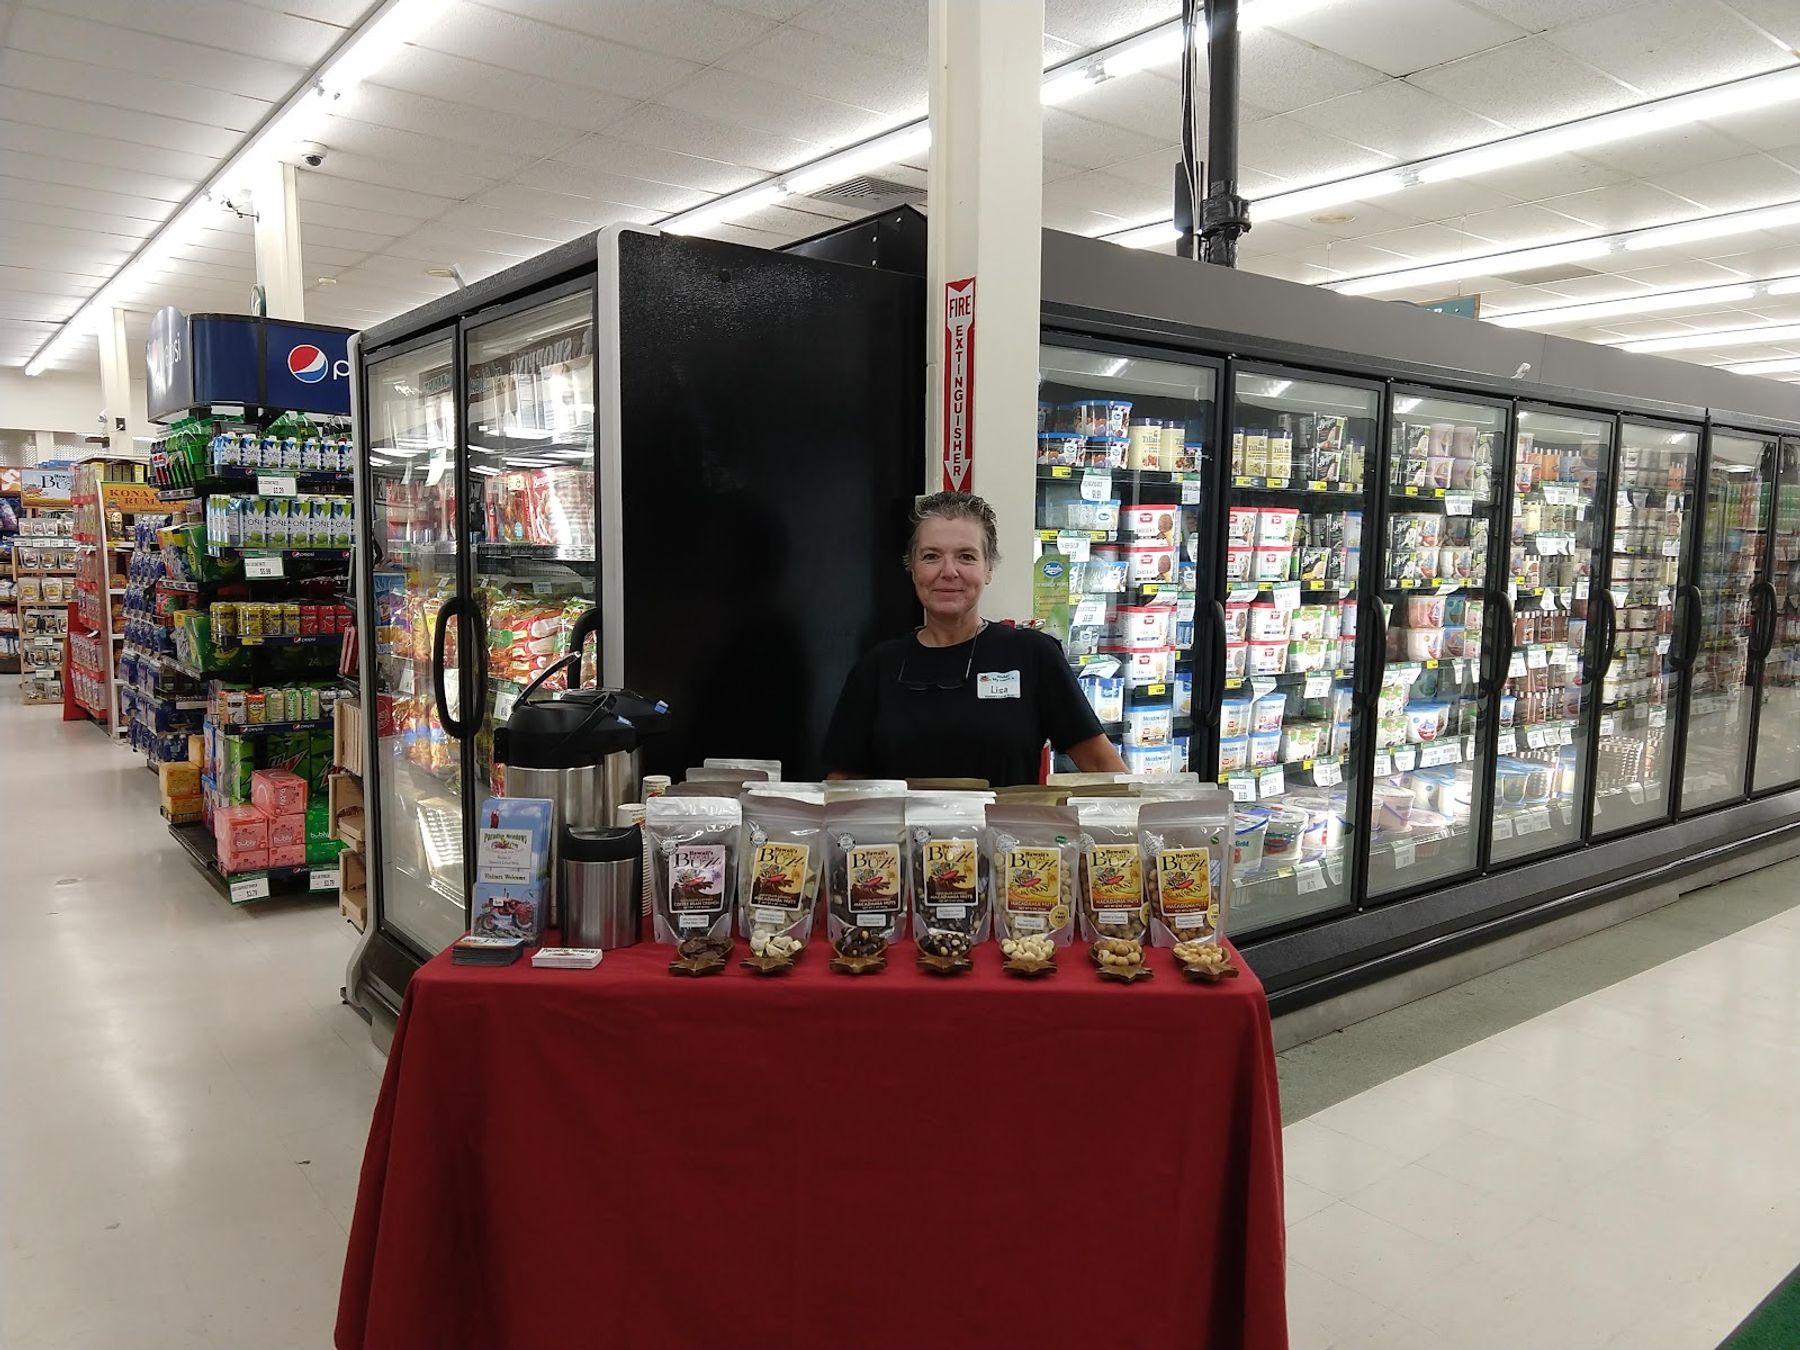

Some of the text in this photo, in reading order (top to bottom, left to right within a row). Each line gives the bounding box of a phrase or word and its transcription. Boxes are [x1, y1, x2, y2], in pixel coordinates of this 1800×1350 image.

[949, 295, 972, 318] FIRE
[952, 325, 964, 477] EXTINGUISHER
[109, 489, 149, 498] KONA
